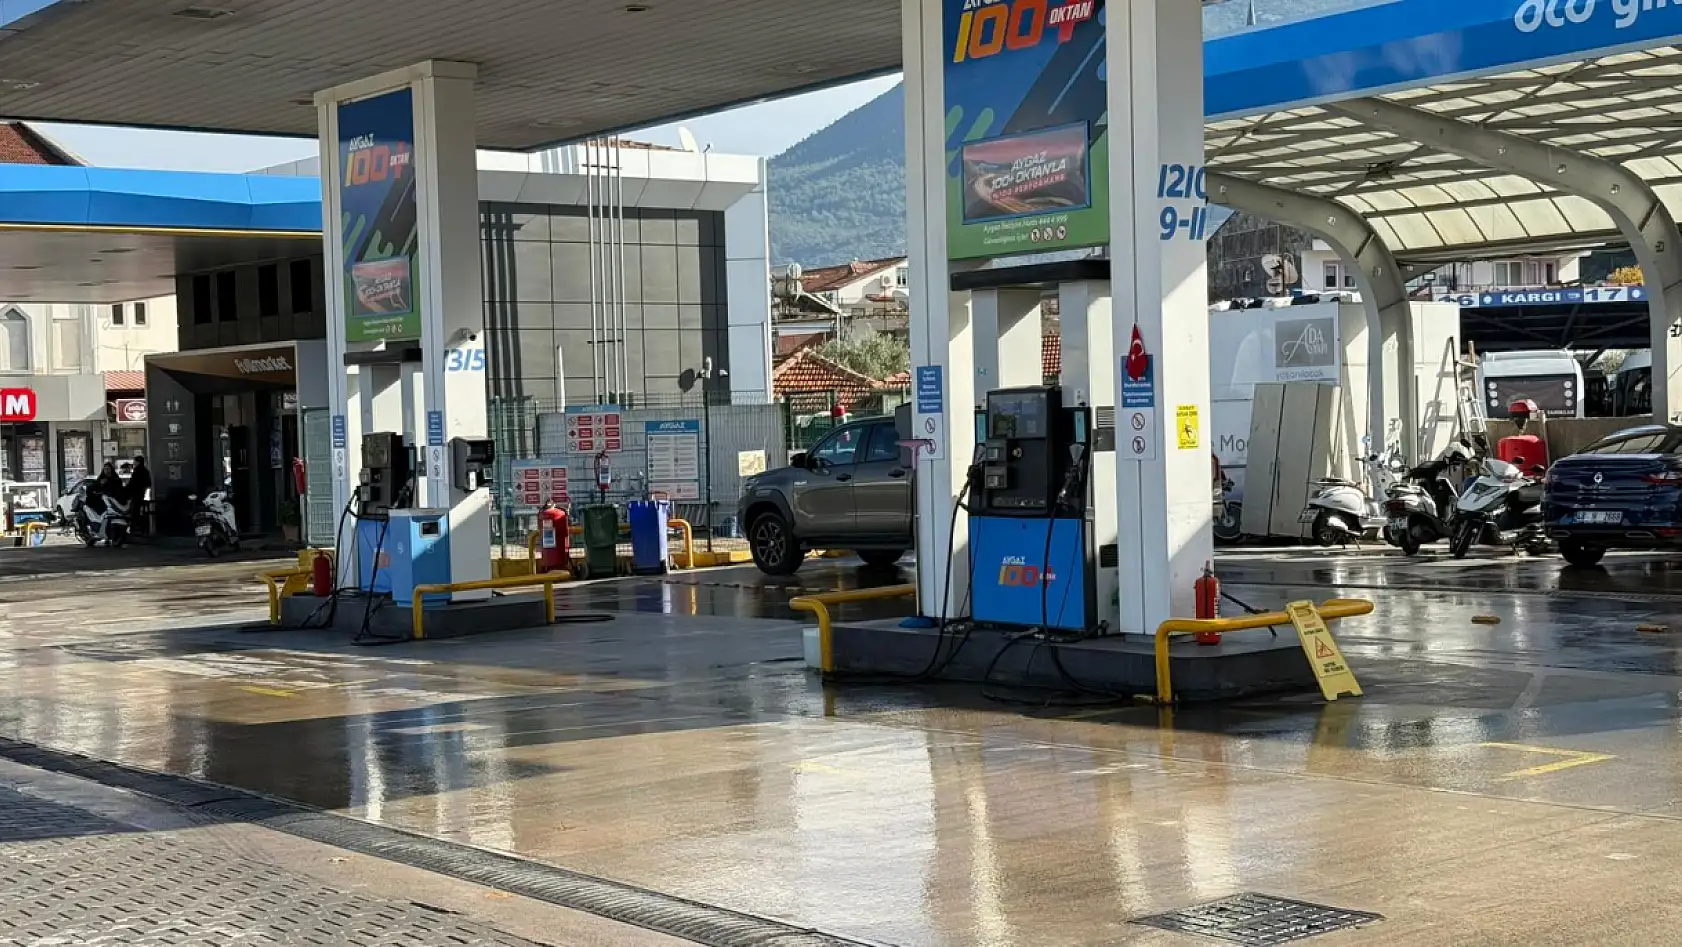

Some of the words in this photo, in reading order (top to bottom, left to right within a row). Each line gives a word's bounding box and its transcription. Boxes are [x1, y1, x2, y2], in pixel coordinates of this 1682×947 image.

[1050, 1, 1092, 24] OKTAN
[349, 133, 374, 151] AYGAZ
[1011, 151, 1047, 171] AYGAZ
[1160, 206, 1206, 241] 9-11
[1502, 291, 1561, 304] KARGI
[1586, 287, 1622, 301] 17
[1220, 434, 1250, 452] Mo
[1002, 555, 1026, 565] AYGAZ
